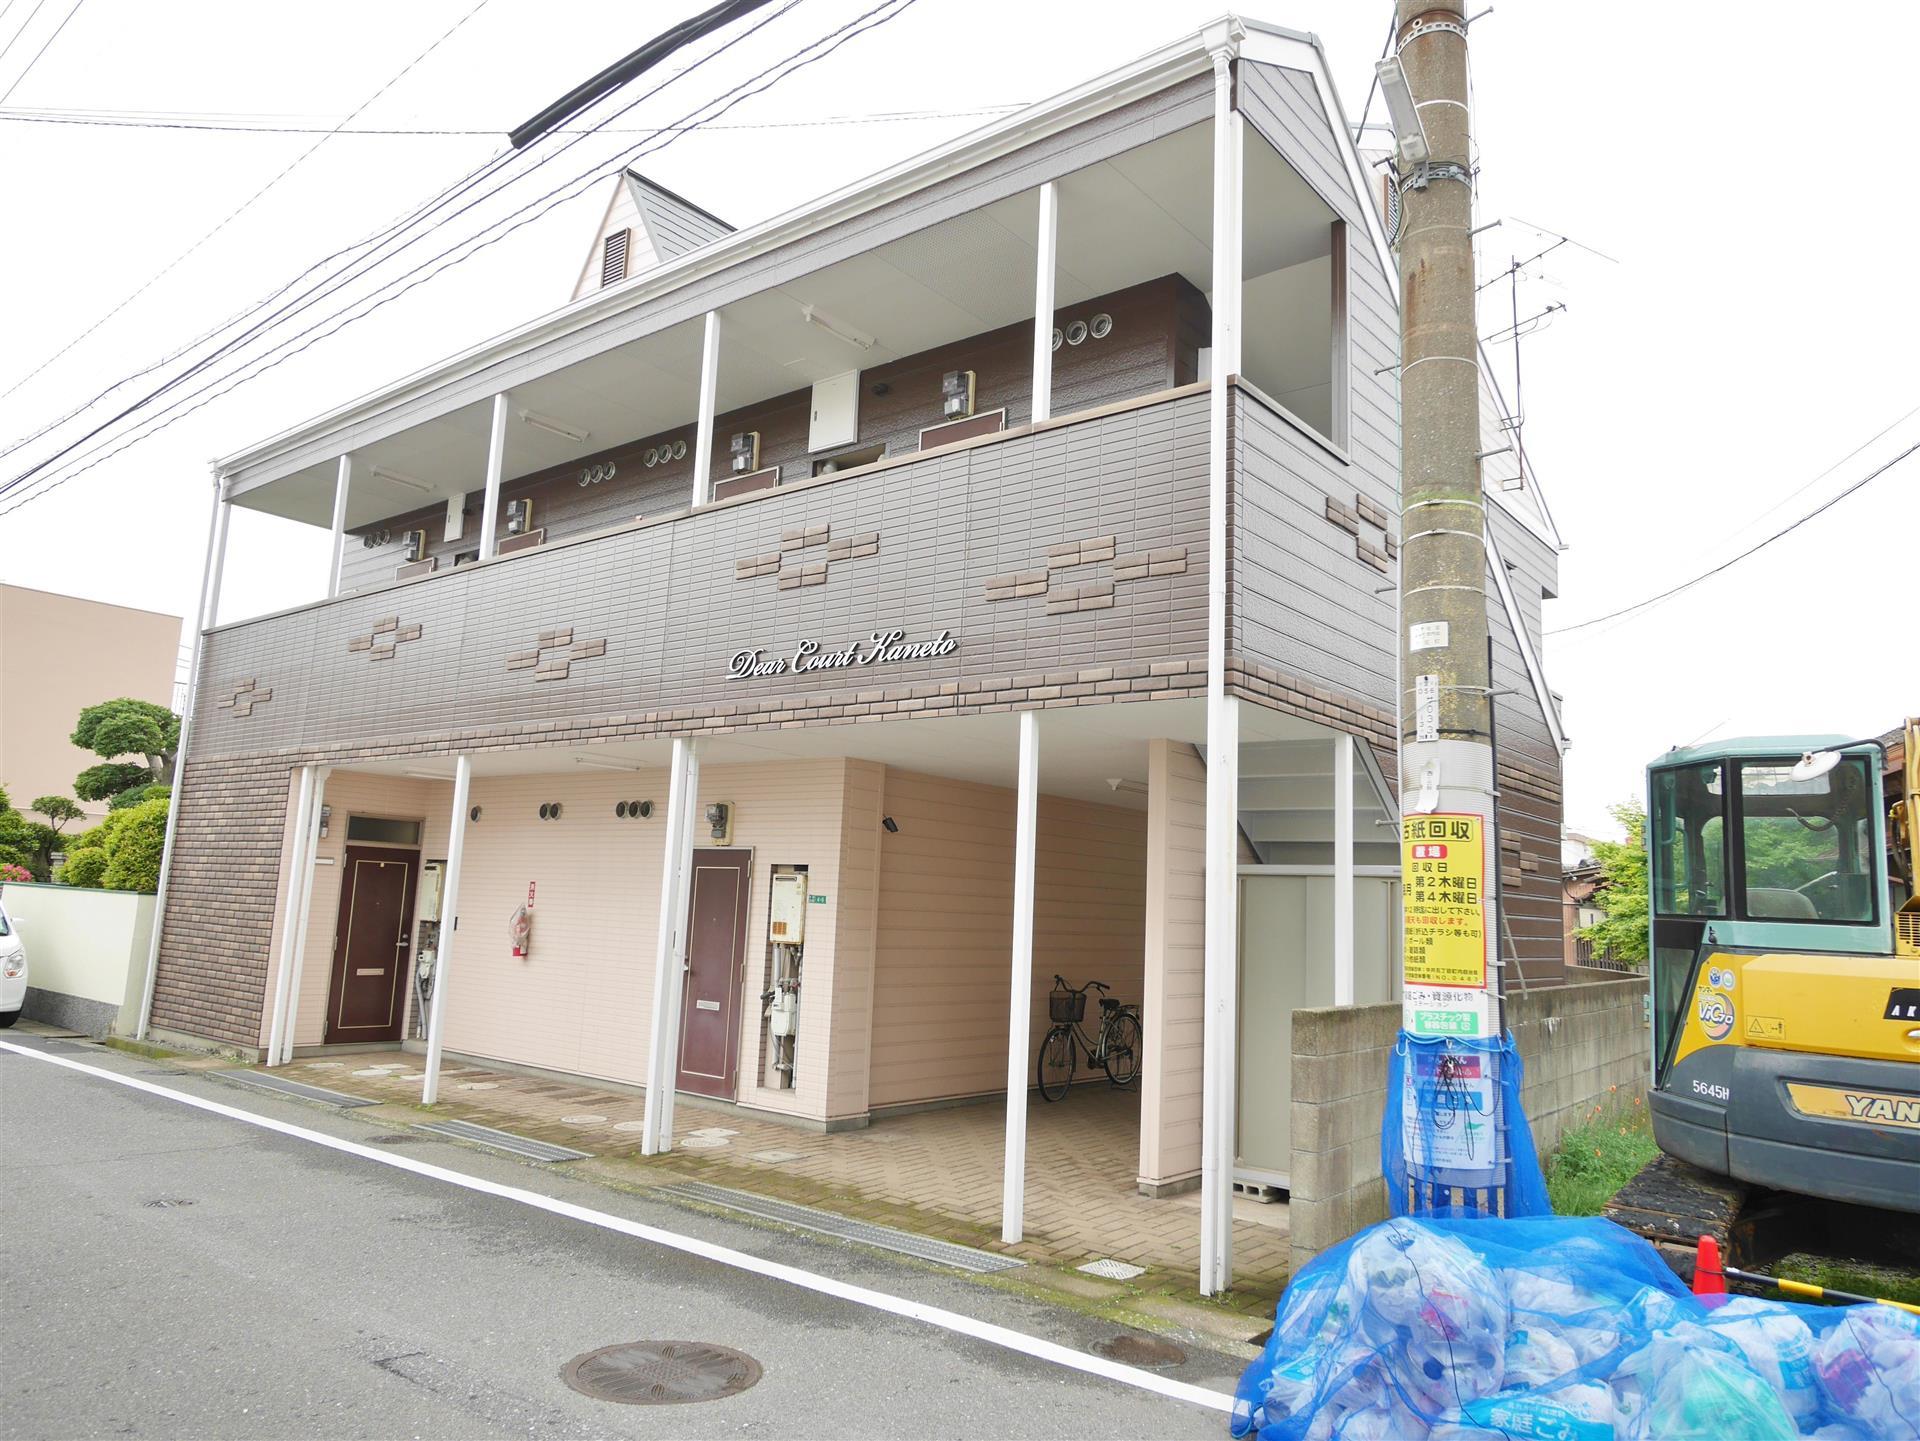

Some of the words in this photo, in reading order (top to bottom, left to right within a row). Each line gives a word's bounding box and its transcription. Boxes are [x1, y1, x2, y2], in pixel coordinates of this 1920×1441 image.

[725, 648, 786, 680] Dear
[791, 640, 859, 674] Court
[857, 629, 957, 665] Kaneto
[1411, 862, 1448, 873] 回収日
[1415, 875, 1478, 890] 第2木曜日
[1415, 890, 1478, 905] 第4木曜日
[1692, 1079, 1730, 1100] 5645H
[1845, 1095, 1920, 1123] YAN
